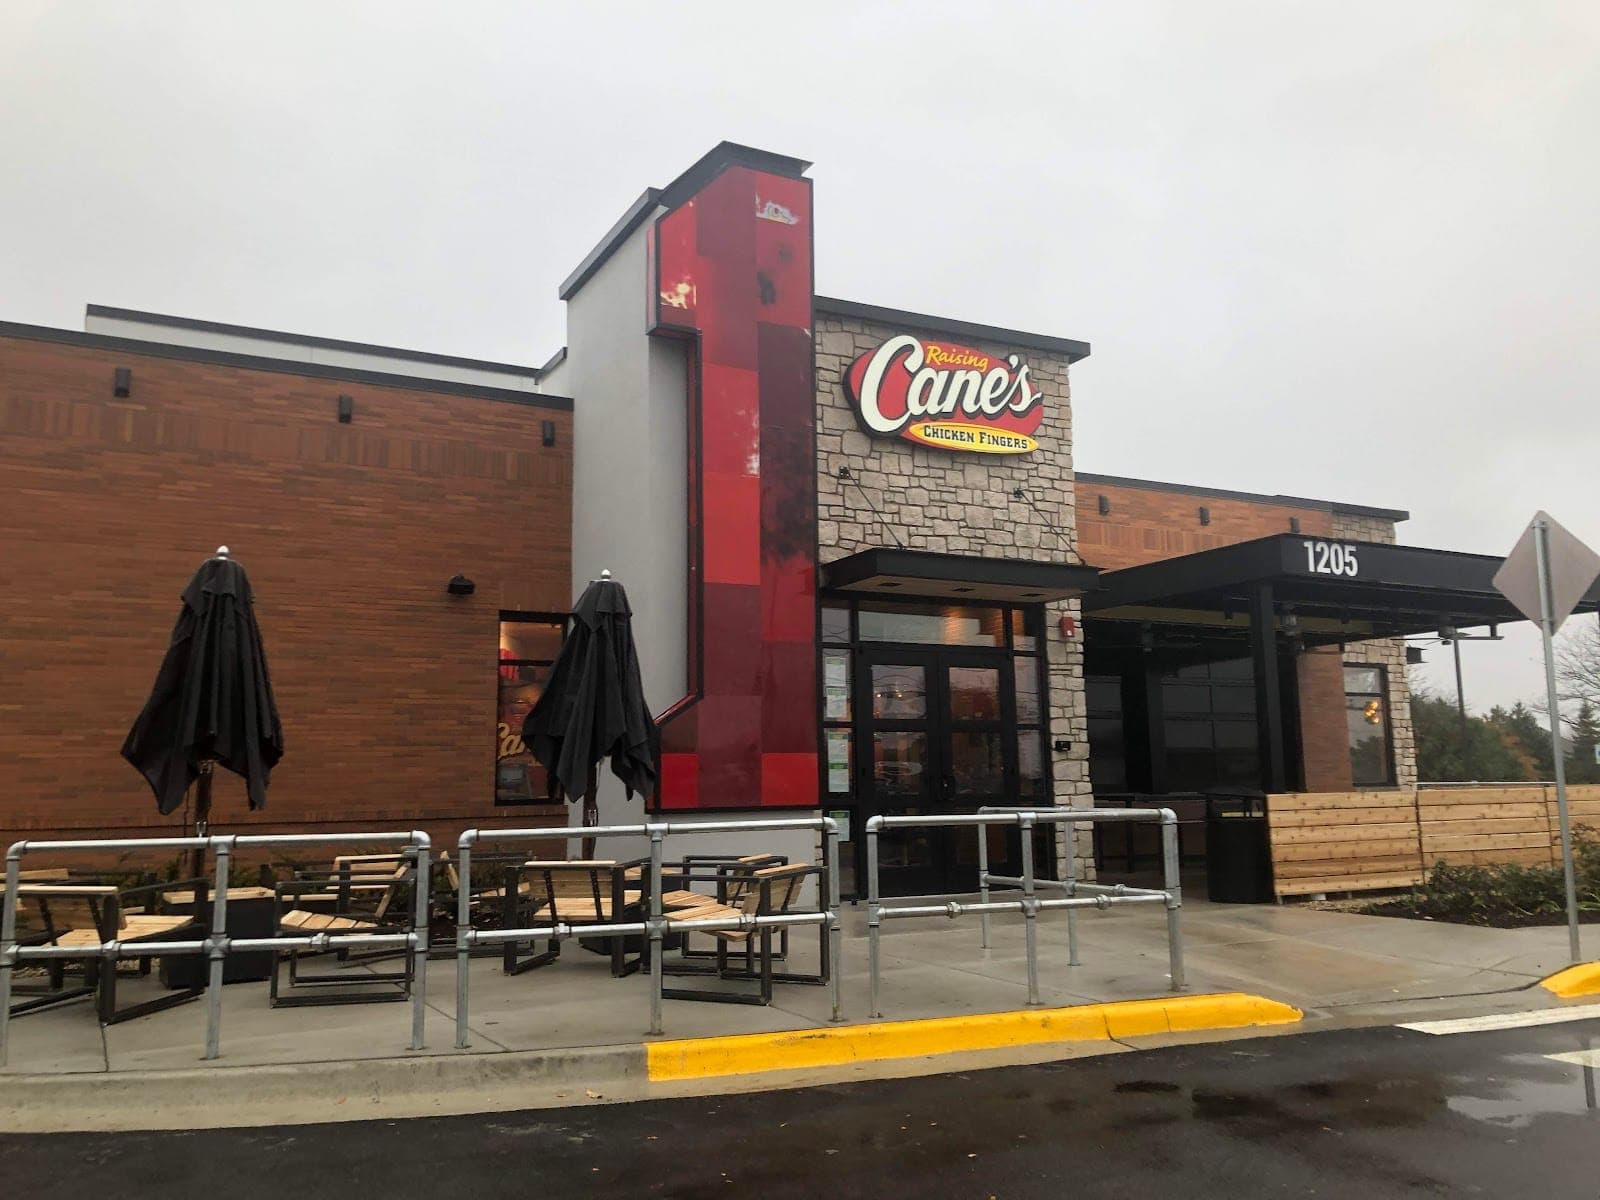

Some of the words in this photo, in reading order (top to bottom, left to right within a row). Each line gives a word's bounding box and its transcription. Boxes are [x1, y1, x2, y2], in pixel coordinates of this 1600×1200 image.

[926, 345, 989, 373] Raising
[860, 335, 1043, 432] Cane's
[924, 425, 974, 443] CHICKEN
[979, 431, 1028, 449] FINGERS
[1303, 541, 1359, 577] 1205
